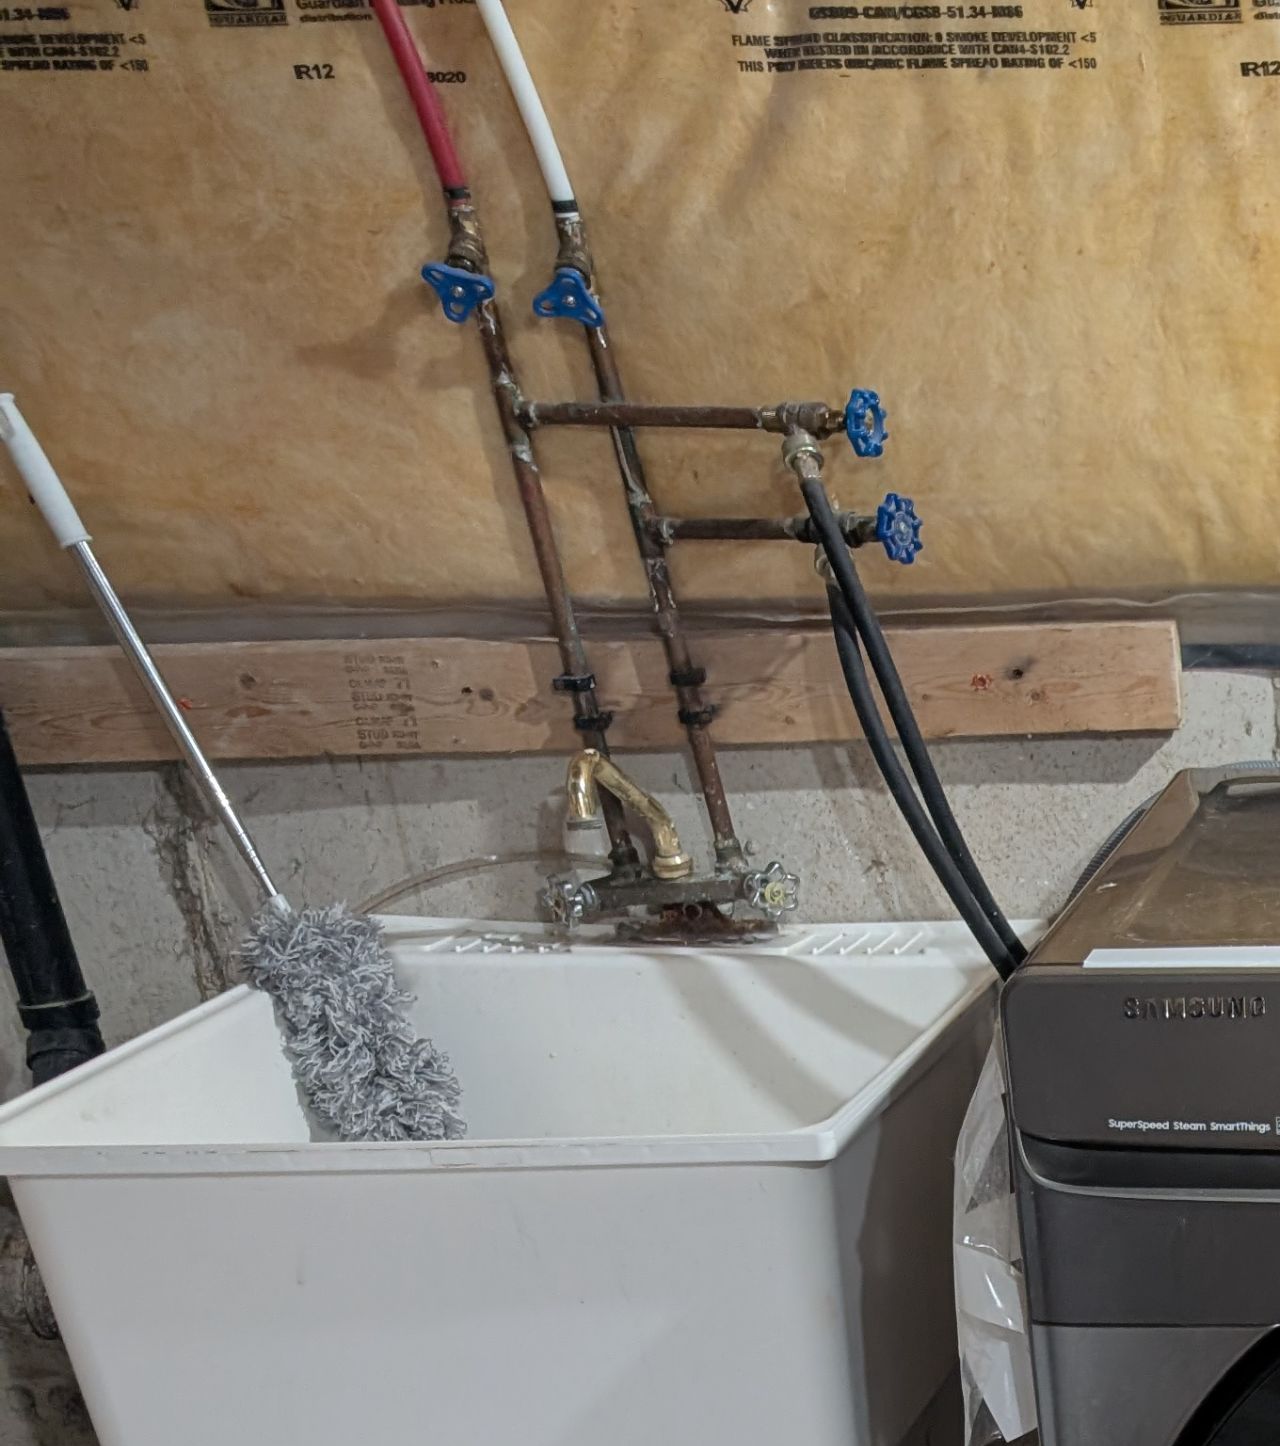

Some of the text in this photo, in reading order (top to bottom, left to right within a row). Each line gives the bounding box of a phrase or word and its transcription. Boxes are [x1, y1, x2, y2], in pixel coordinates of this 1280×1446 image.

[731, 34, 771, 46] FLAME
[1080, 32, 1097, 43] <5
[293, 64, 335, 80] R12
[737, 60, 764, 72] THIS
[1068, 57, 1097, 69] <150
[1123, 997, 1267, 1019] SAMSUNG
[1108, 1118, 1272, 1134] SuperSpeed Steam SmartThings
